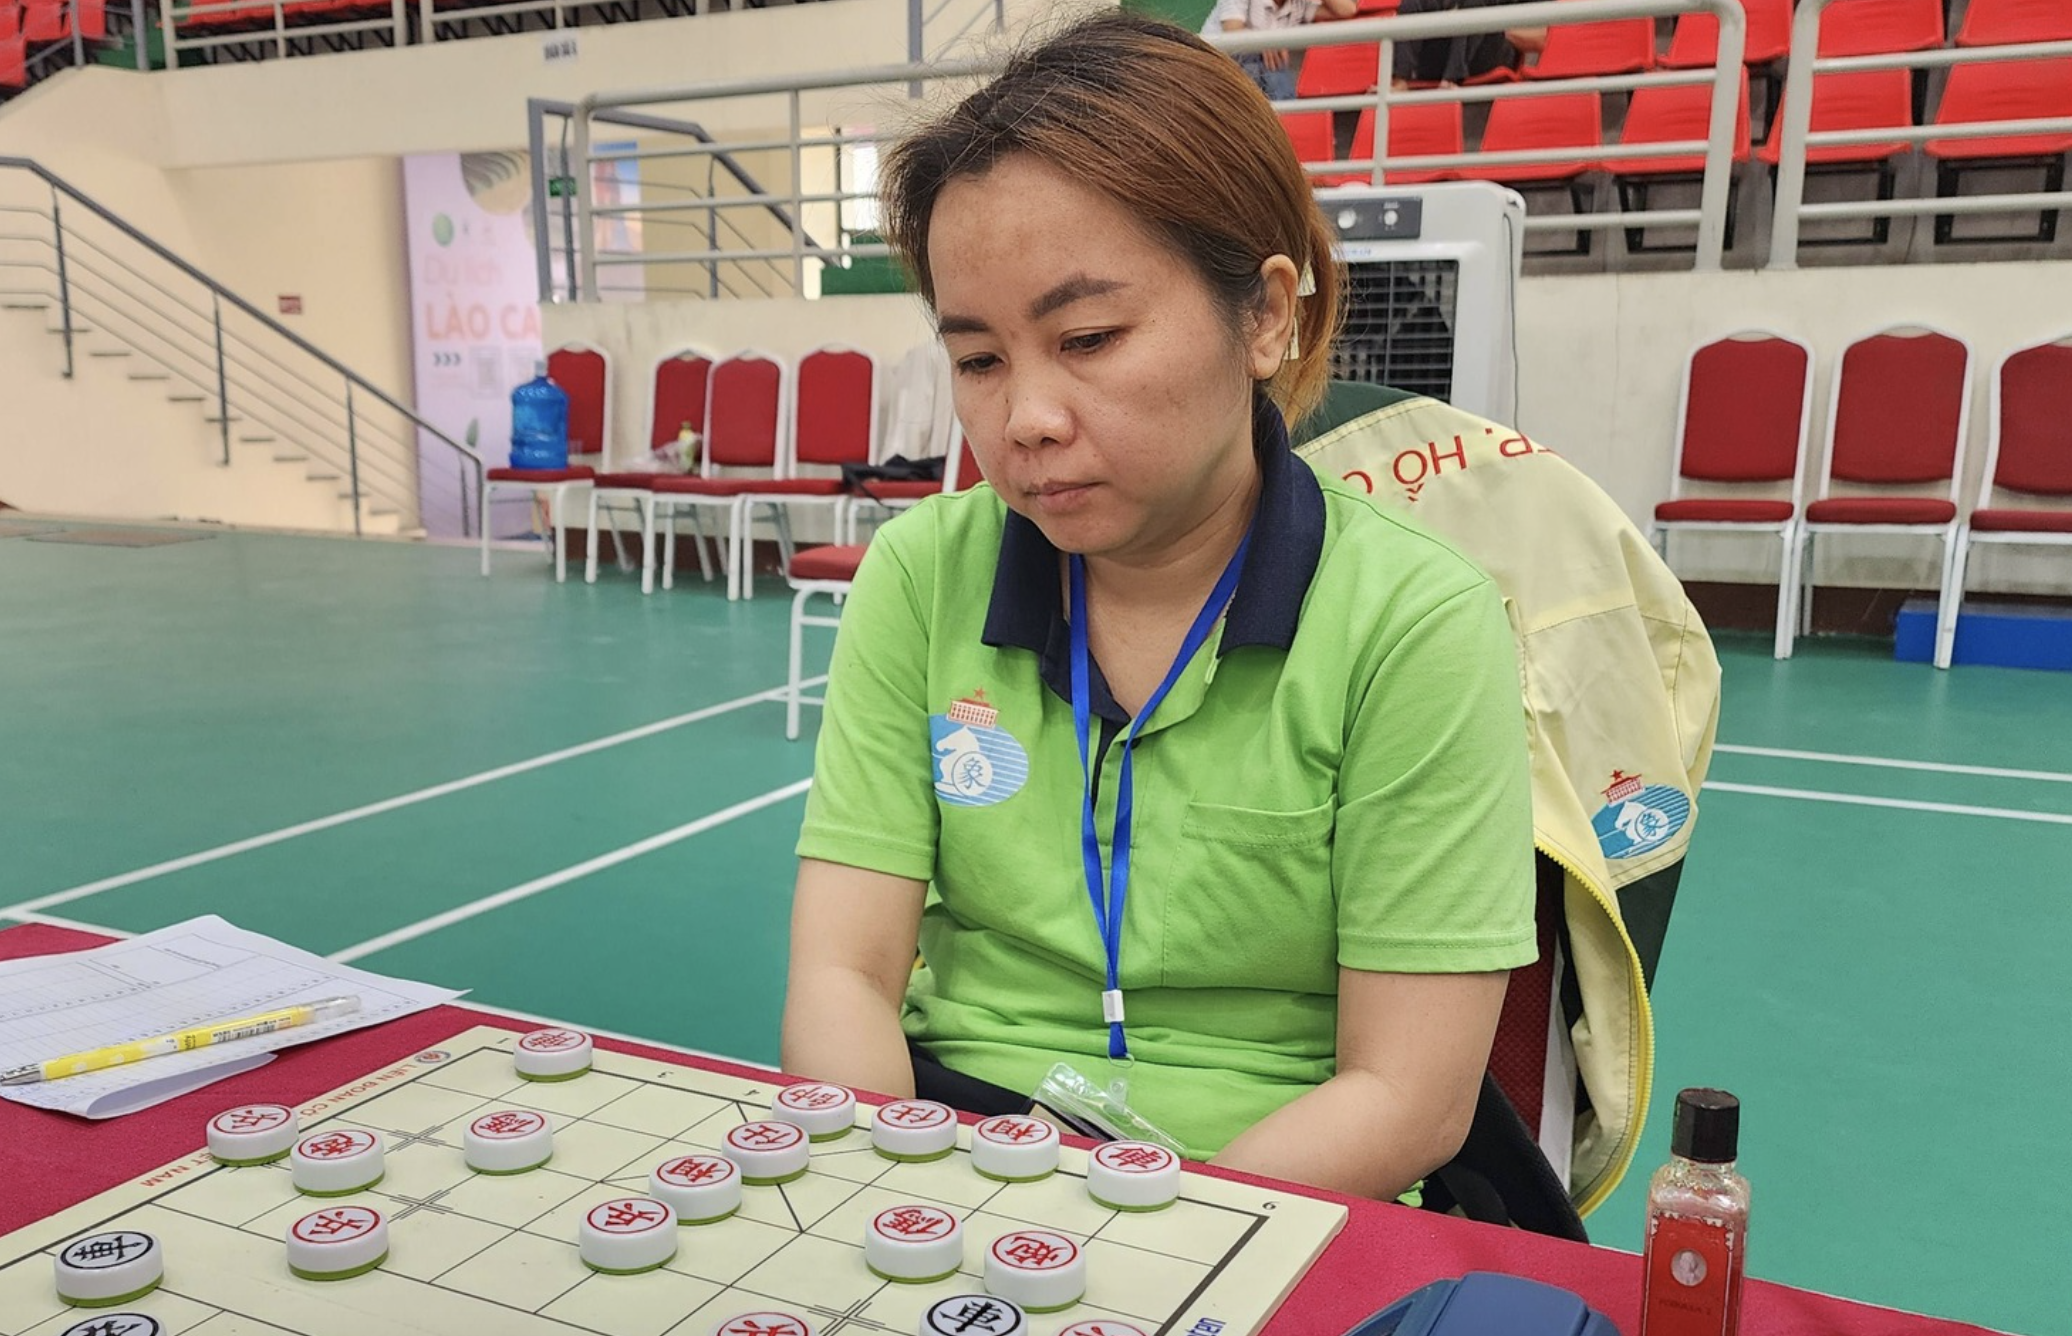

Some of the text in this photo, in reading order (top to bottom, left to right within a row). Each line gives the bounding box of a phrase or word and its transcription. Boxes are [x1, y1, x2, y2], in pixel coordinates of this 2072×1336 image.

[425, 290, 540, 341] LÀO CA
[1393, 435, 1467, 502] HỒ
[889, 1104, 939, 1124] 仕
[741, 1124, 792, 1145] 仕
[986, 1118, 1044, 1142] 相
[664, 1158, 726, 1184] 相
[308, 1210, 371, 1236] 兵
[605, 1202, 661, 1228] 兵
[72, 1236, 143, 1262] 車
[939, 1301, 1003, 1333] 車
